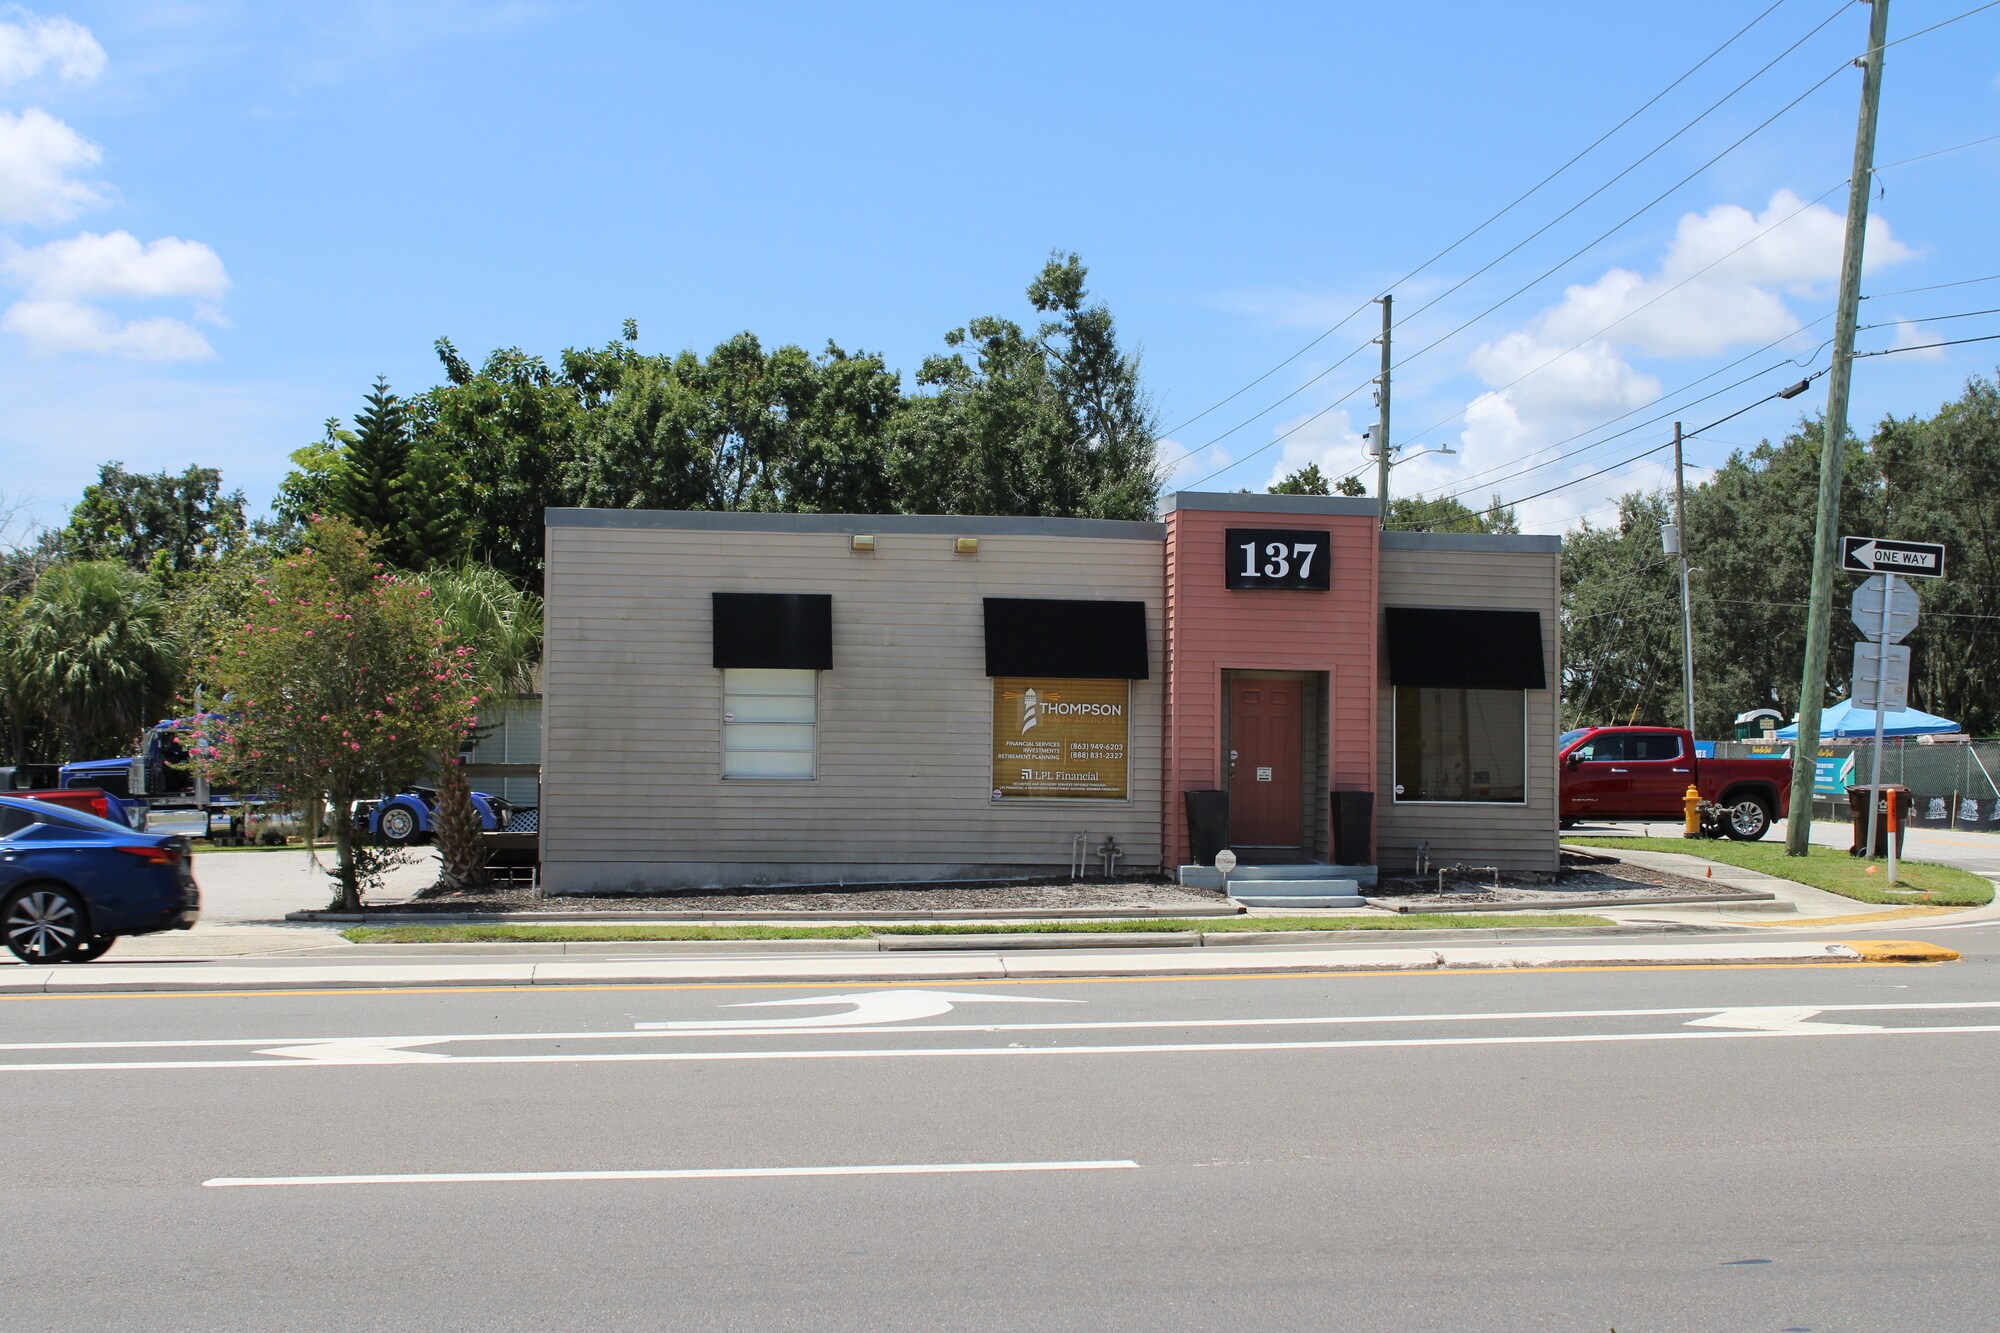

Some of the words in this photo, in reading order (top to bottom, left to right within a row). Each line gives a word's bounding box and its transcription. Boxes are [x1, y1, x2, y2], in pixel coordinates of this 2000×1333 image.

[1240, 542, 1317, 579] 137
[1874, 550, 1899, 563] ONE
[1902, 552, 1928, 565] WAY
[1040, 702, 1122, 716] THOMPSON
[1090, 743, 1123, 751] 949-6203
[1070, 751, 1089, 759] (888)
[1035, 771, 1054, 780] LPL
[1055, 771, 1099, 781] Financial
